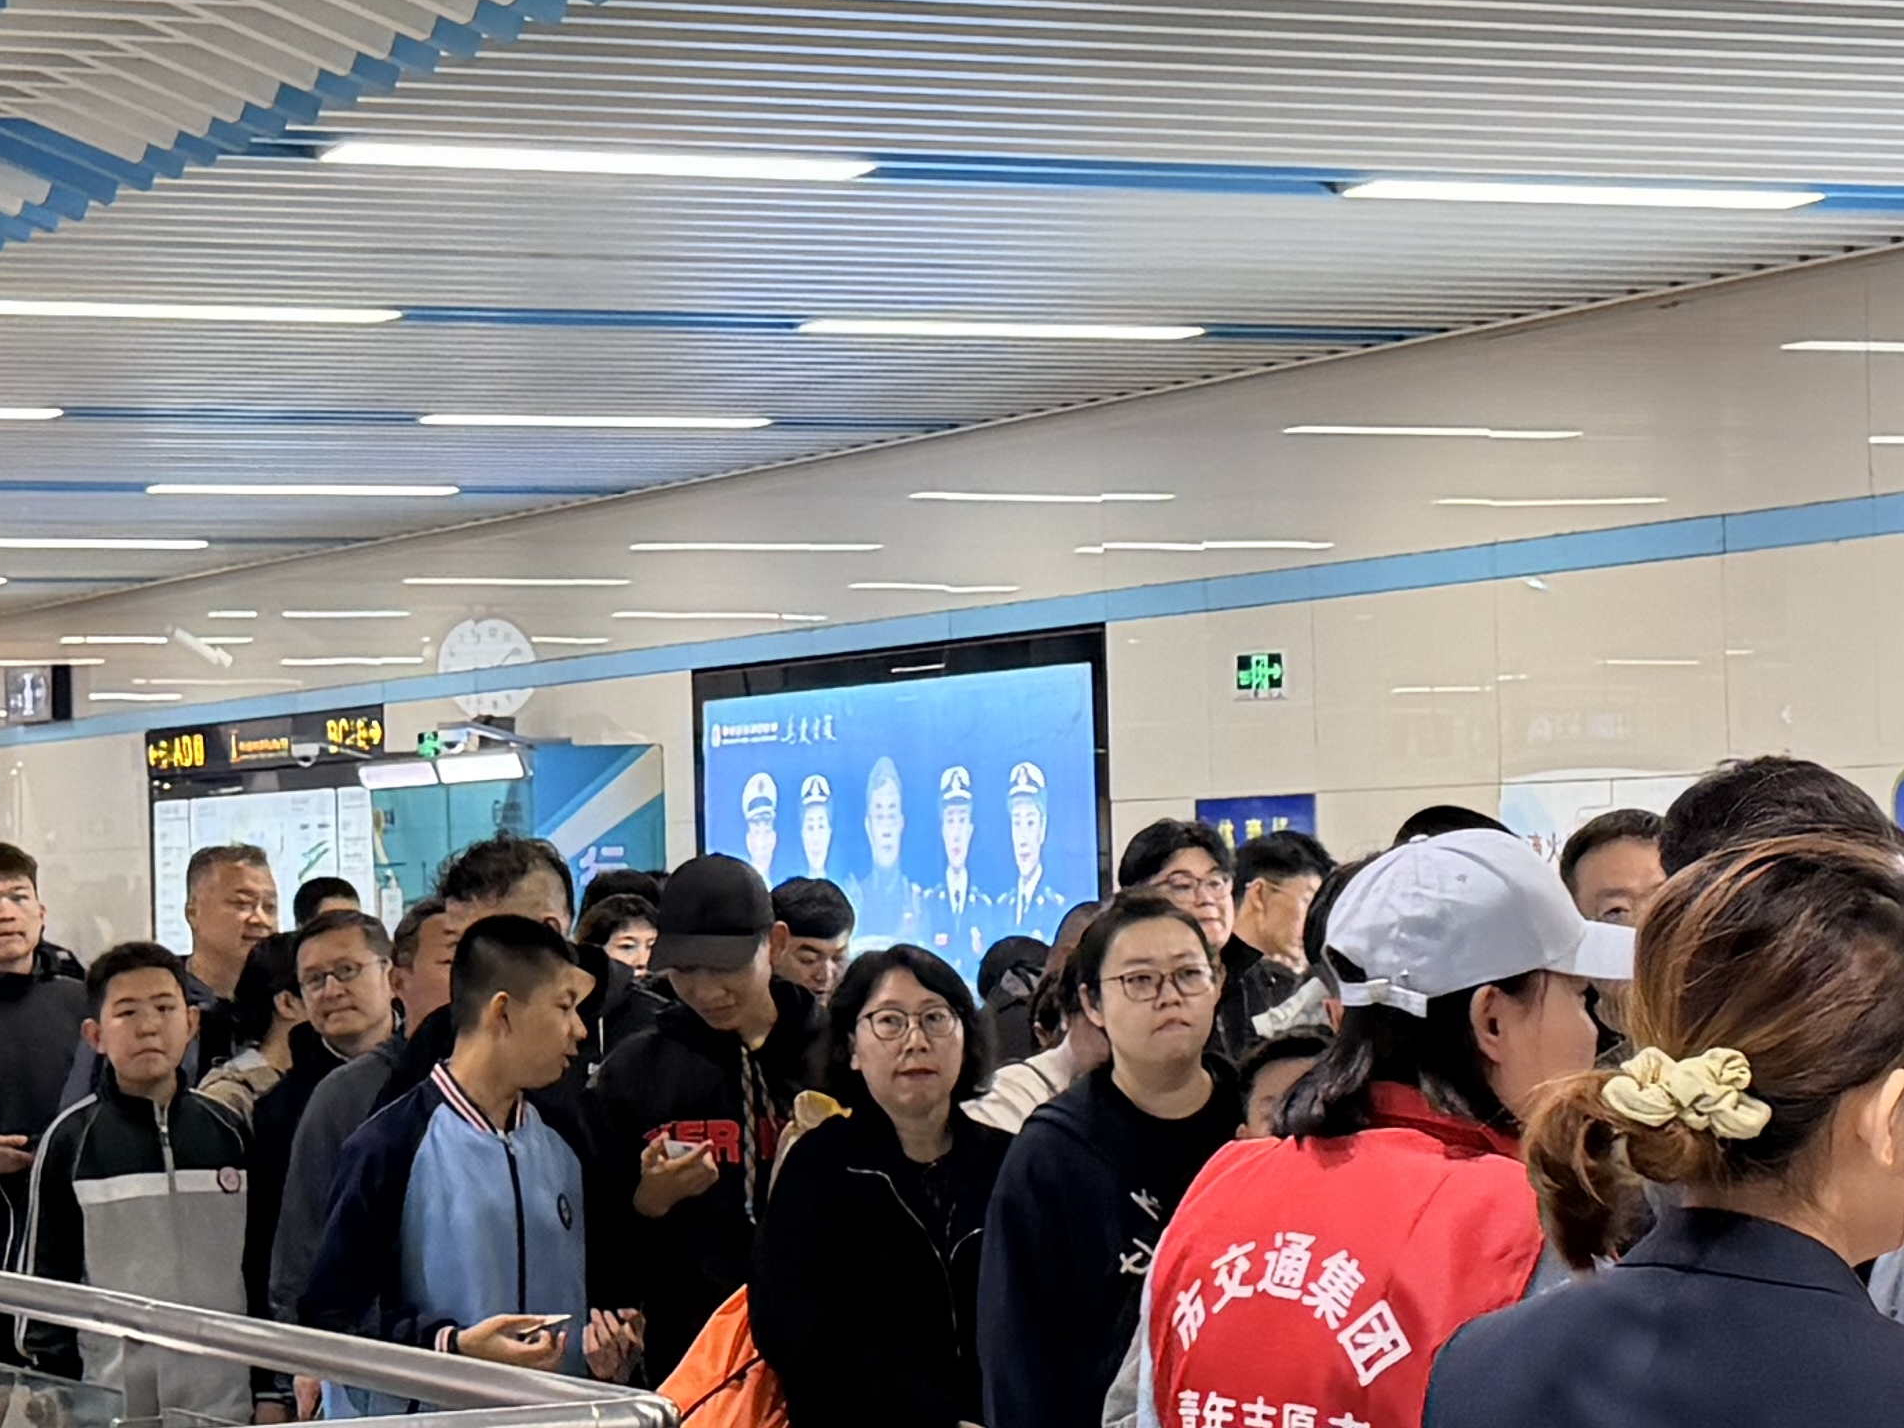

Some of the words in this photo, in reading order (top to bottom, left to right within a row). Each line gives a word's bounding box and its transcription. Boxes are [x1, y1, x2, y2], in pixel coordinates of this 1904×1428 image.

[1172, 1231, 1413, 1387] 市交通集团
